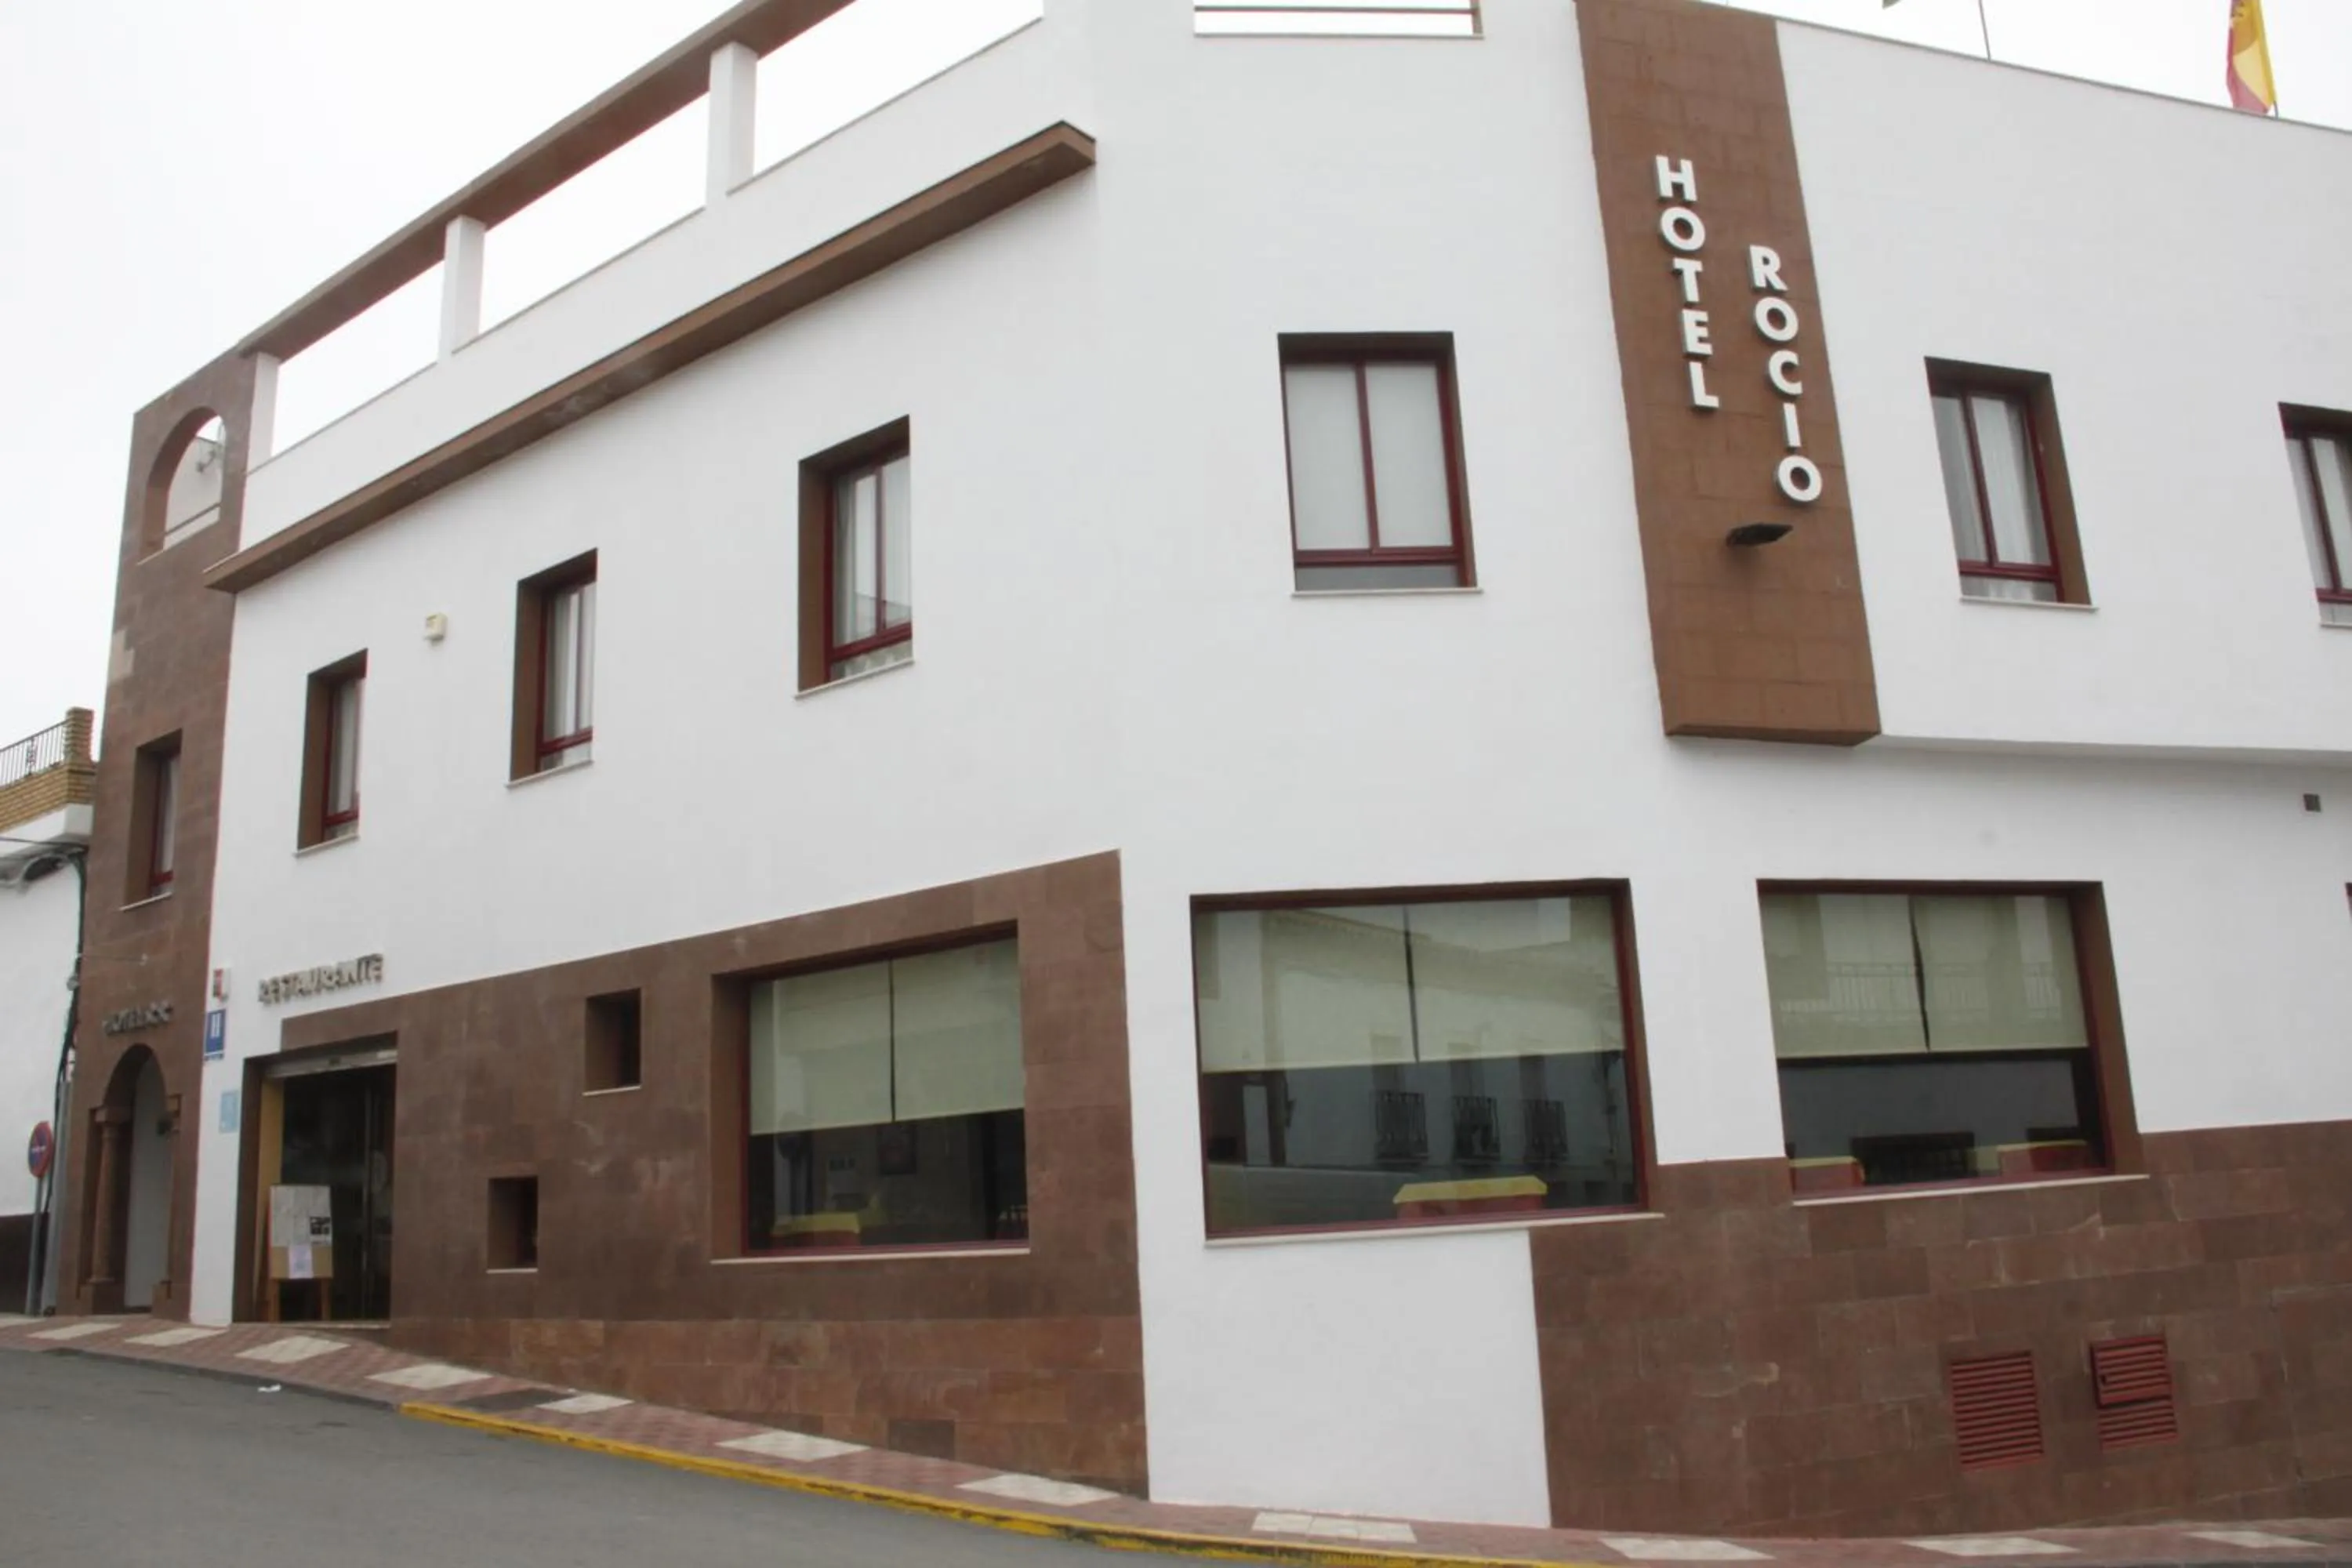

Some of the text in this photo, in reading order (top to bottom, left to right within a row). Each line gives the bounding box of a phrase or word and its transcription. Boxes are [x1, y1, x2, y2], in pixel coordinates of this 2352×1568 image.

[1654, 154, 1719, 408] HOTEL
[1747, 244, 1822, 503] ROCIO
[258, 953, 383, 1004] RESTAURANTE
